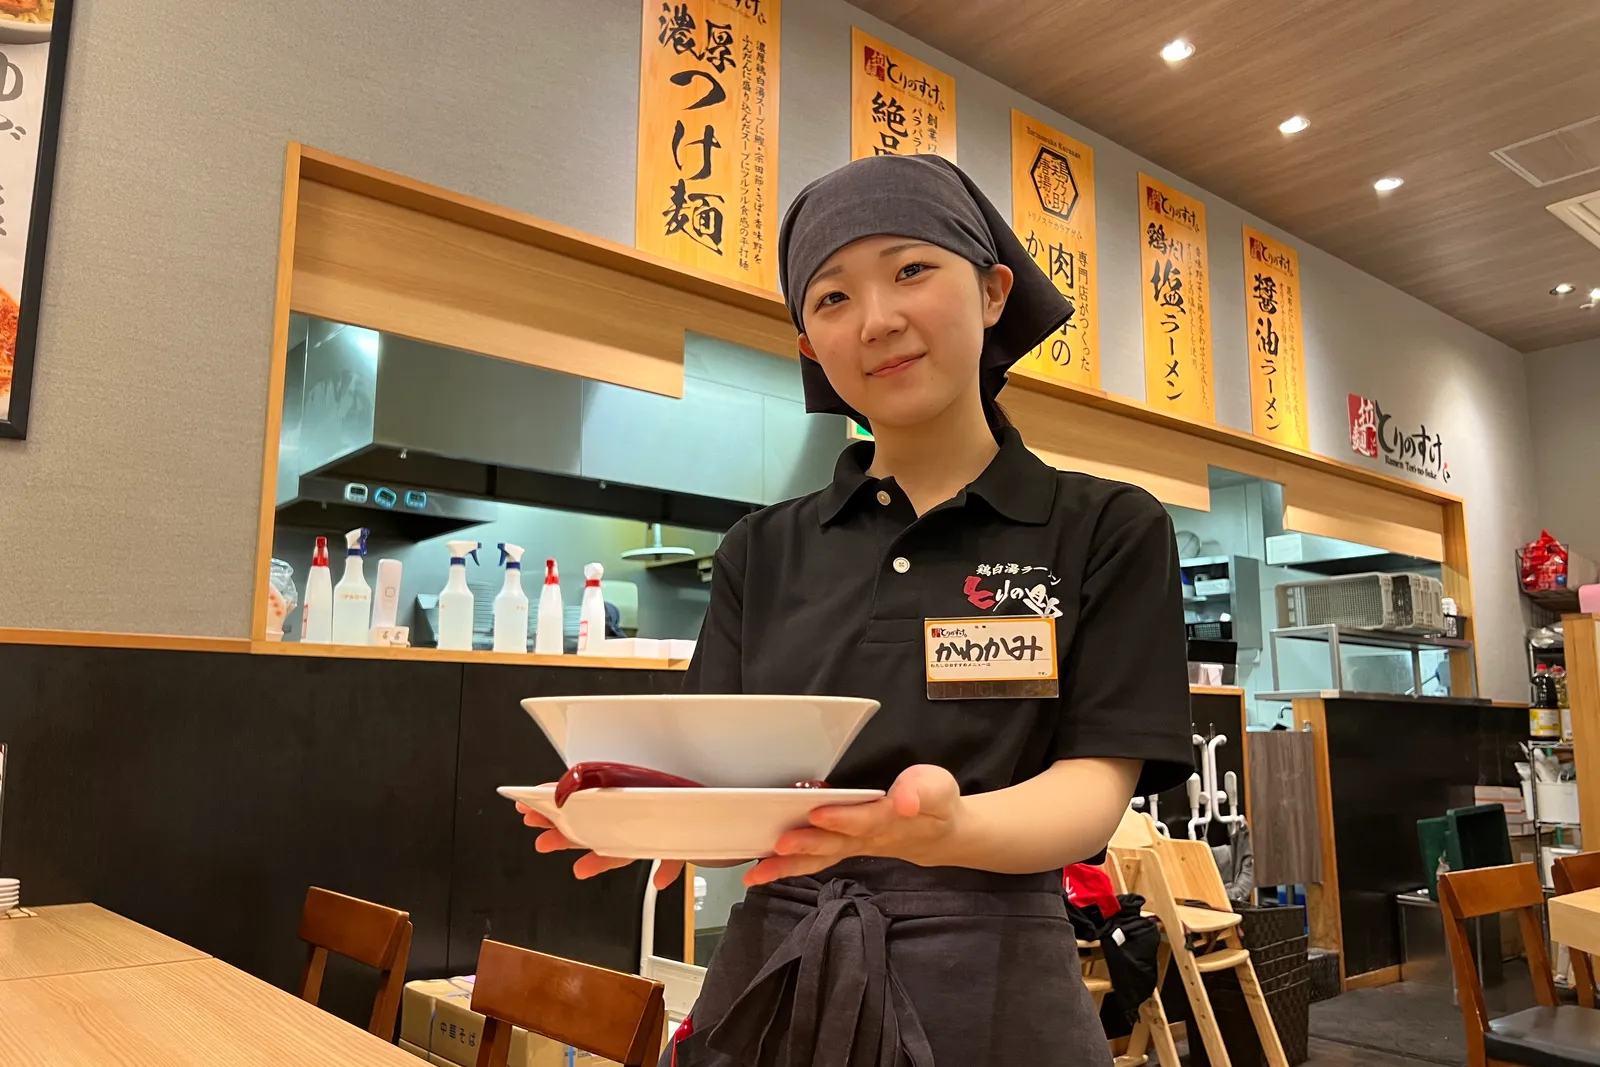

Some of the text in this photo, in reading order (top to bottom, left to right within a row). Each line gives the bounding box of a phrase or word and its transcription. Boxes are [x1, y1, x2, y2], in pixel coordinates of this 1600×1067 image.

[886, 56, 940, 104] とりのすけ
[1078, 250, 1091, 373] 専門店がつくった
[1151, 259, 1187, 402] 塩ラーメン
[1253, 273, 1281, 431] 醤油ラーメン
[1375, 399, 1443, 472] とりのすけ
[935, 635, 1043, 662] かわかみ
